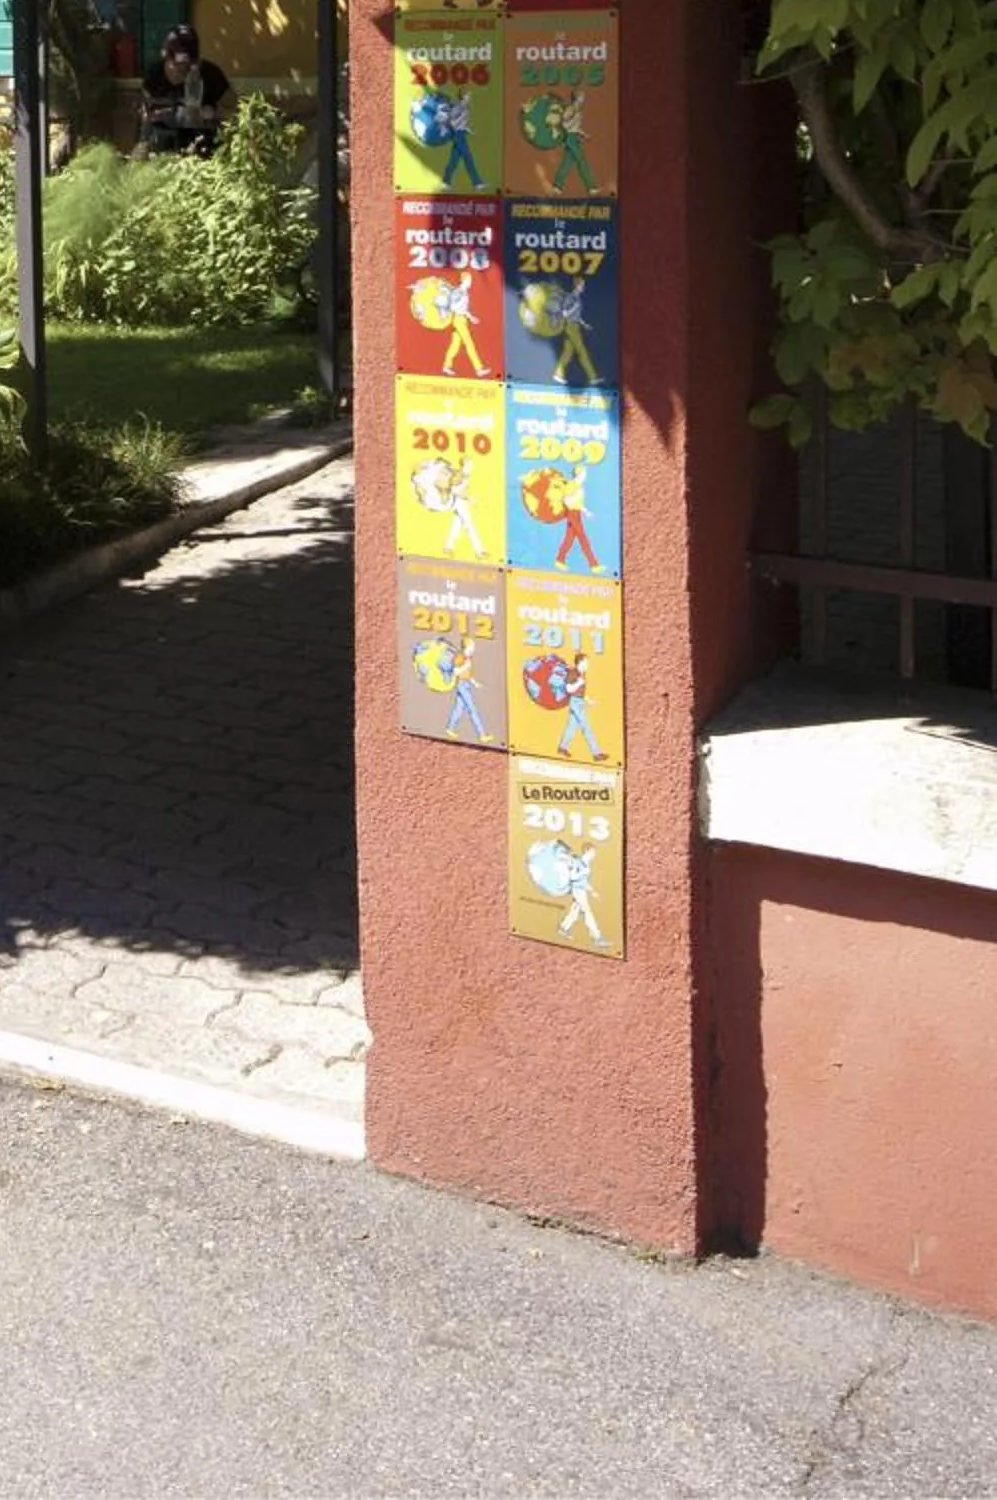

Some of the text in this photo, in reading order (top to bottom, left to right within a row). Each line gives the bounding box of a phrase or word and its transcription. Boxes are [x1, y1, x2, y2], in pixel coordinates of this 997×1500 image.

[406, 42, 492, 61] routard
[515, 41, 608, 61] routard
[410, 63, 490, 86] 2006
[405, 226, 493, 245] routard
[514, 230, 607, 251] routard
[408, 246, 491, 271] 2008
[518, 249, 605, 276] 2007
[412, 427, 492, 456] 2010
[516, 418, 609, 441] routard
[519, 435, 606, 466] 2009
[408, 590, 496, 616] routard
[411, 606, 494, 640] 2012
[517, 605, 610, 630] routard
[523, 623, 605, 655] 2011
[522, 803, 611, 841] 2013
